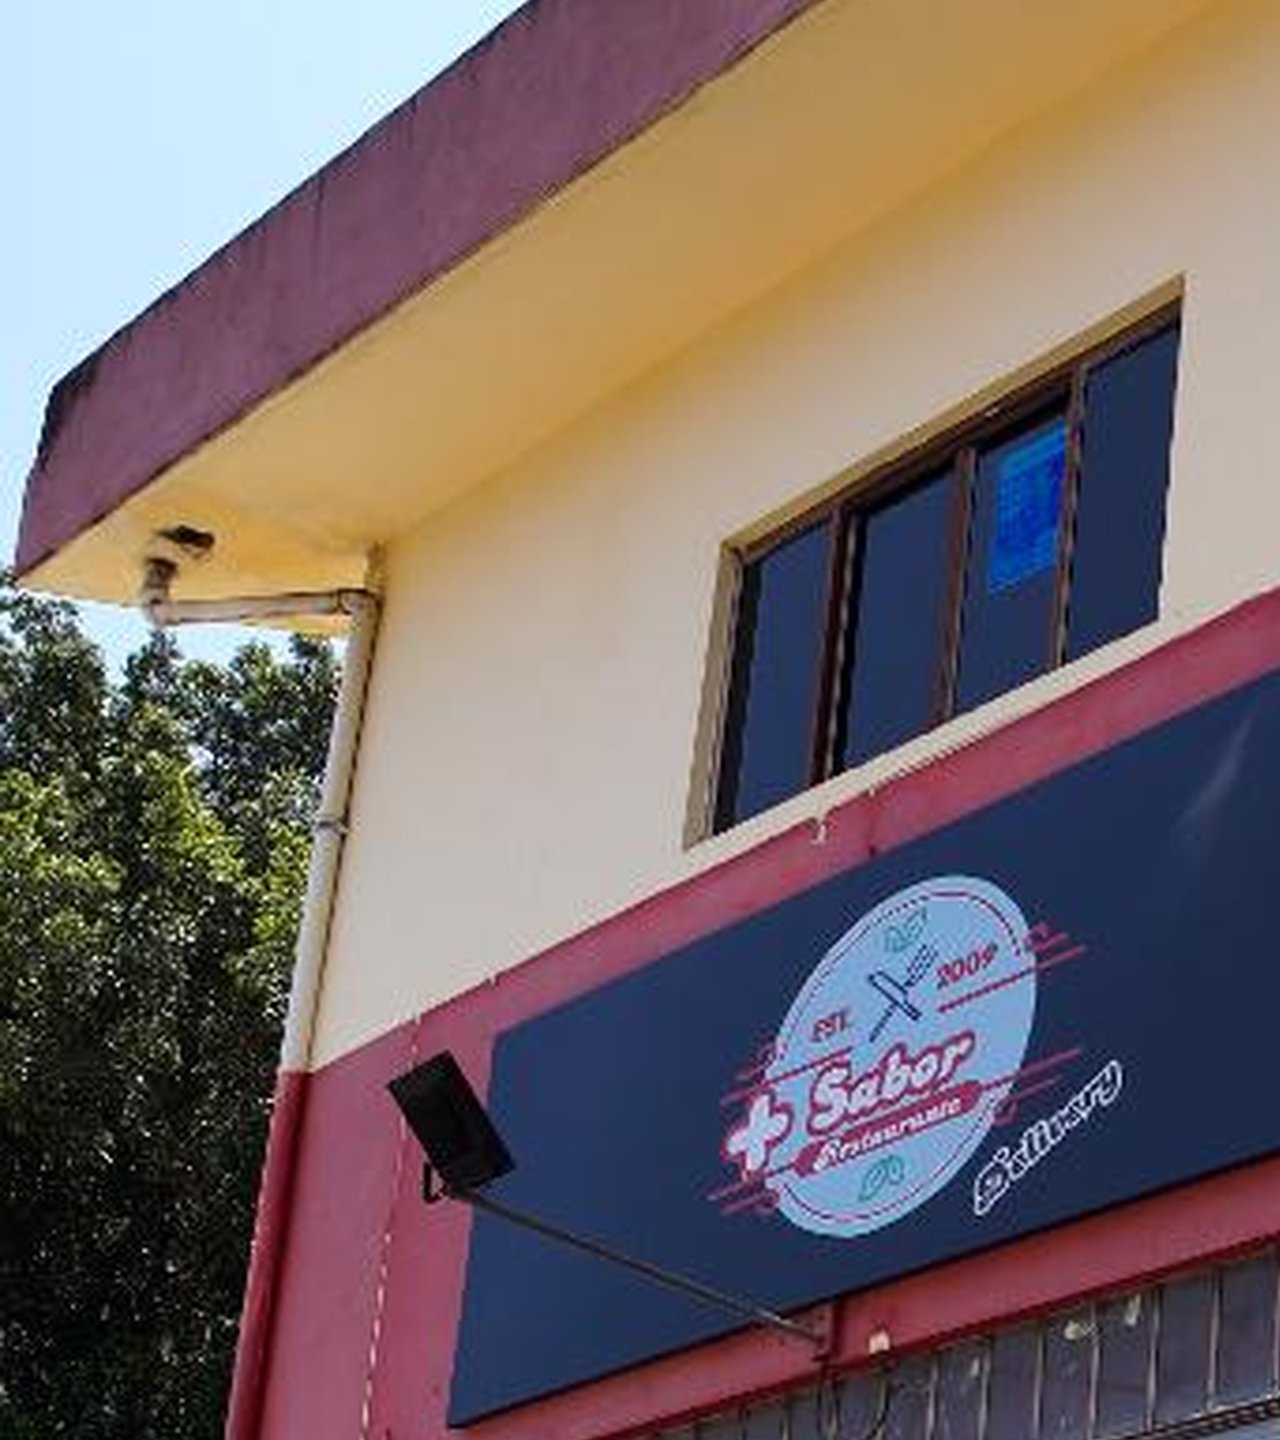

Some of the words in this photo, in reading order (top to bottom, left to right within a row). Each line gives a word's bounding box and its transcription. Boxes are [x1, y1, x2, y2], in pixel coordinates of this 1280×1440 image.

[936, 942, 998, 990] 2009
[807, 1030, 976, 1137] Sabor
[812, 1097, 962, 1172] Restaurante
[974, 1059, 1123, 1216] Delivery
